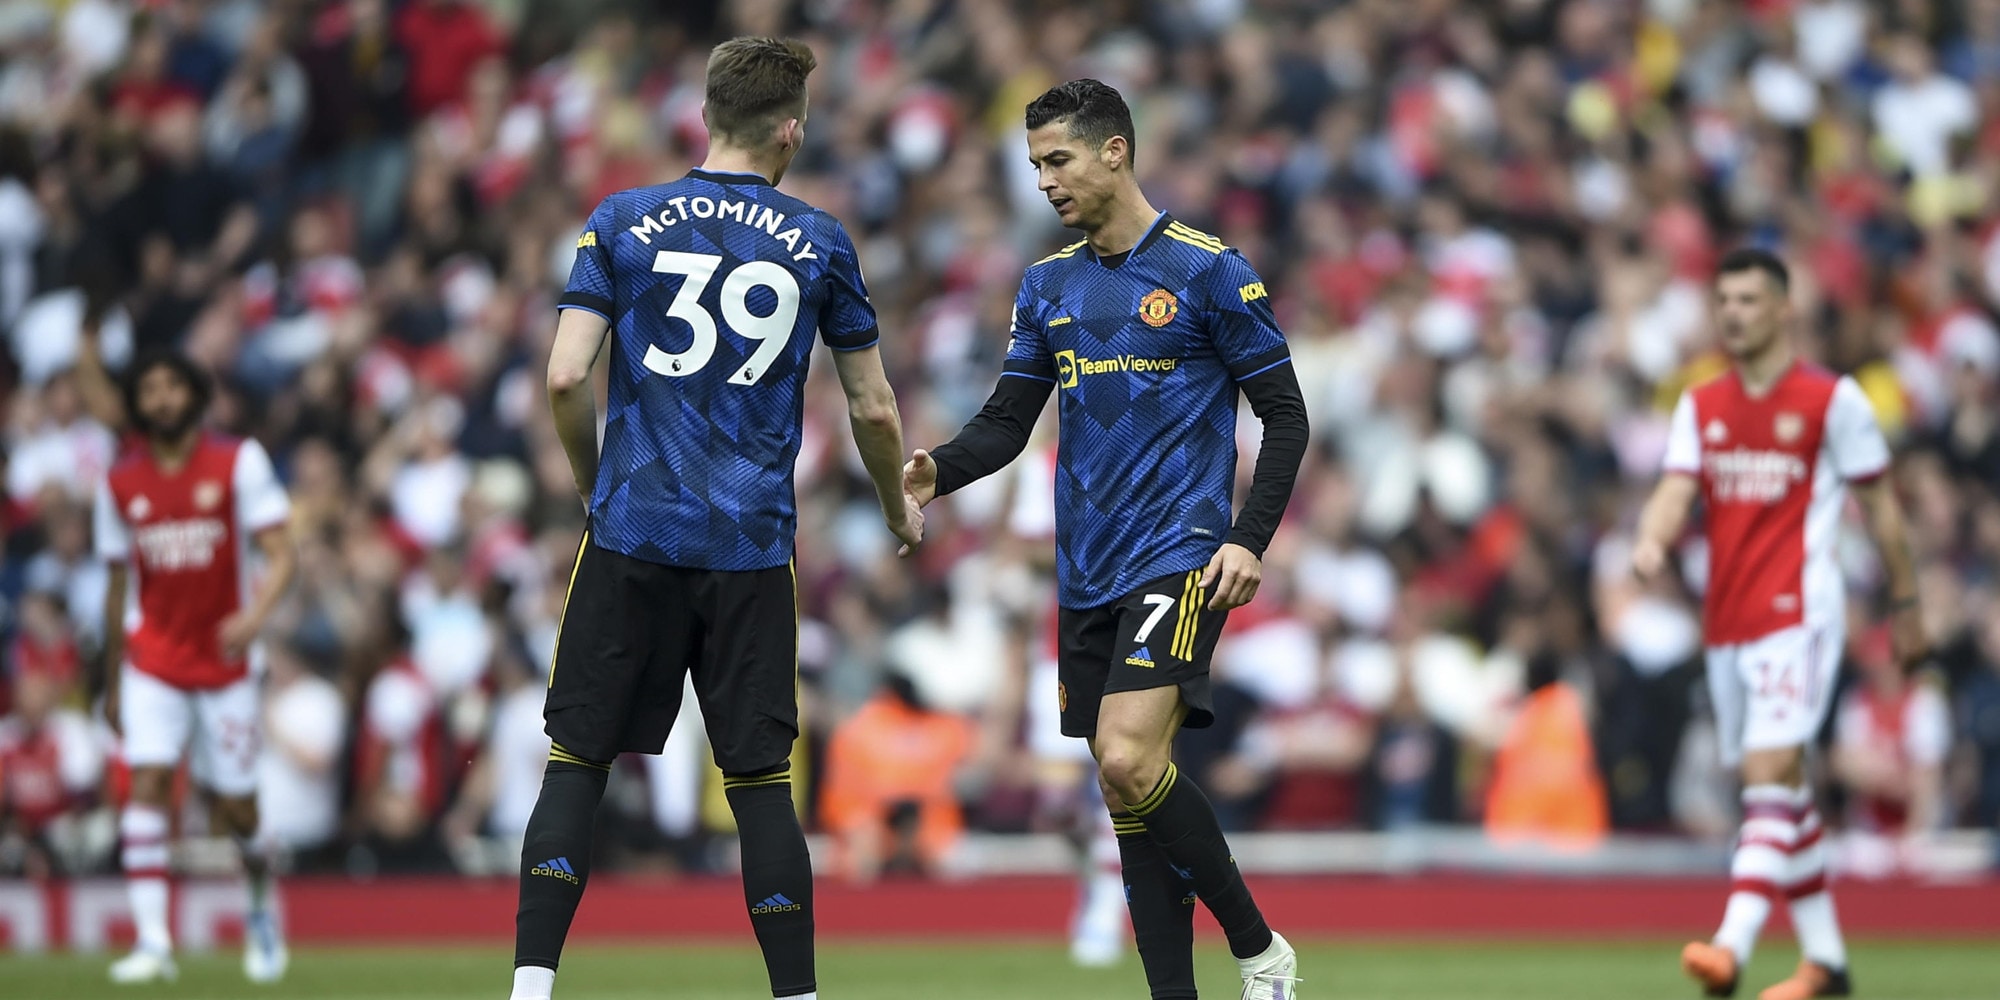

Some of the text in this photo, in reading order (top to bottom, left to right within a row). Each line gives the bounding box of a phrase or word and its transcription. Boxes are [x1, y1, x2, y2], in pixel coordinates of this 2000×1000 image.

[629, 196, 817, 262] McTOMINAY
[642, 250, 800, 386] 39
[1049, 316, 1071, 327] adidas
[1076, 354, 1178, 375] TeamViewer
[1134, 594, 1176, 643] 7
[1125, 656, 1155, 669] adidas
[531, 866, 579, 886] adidas
[752, 902, 801, 915] adidas
